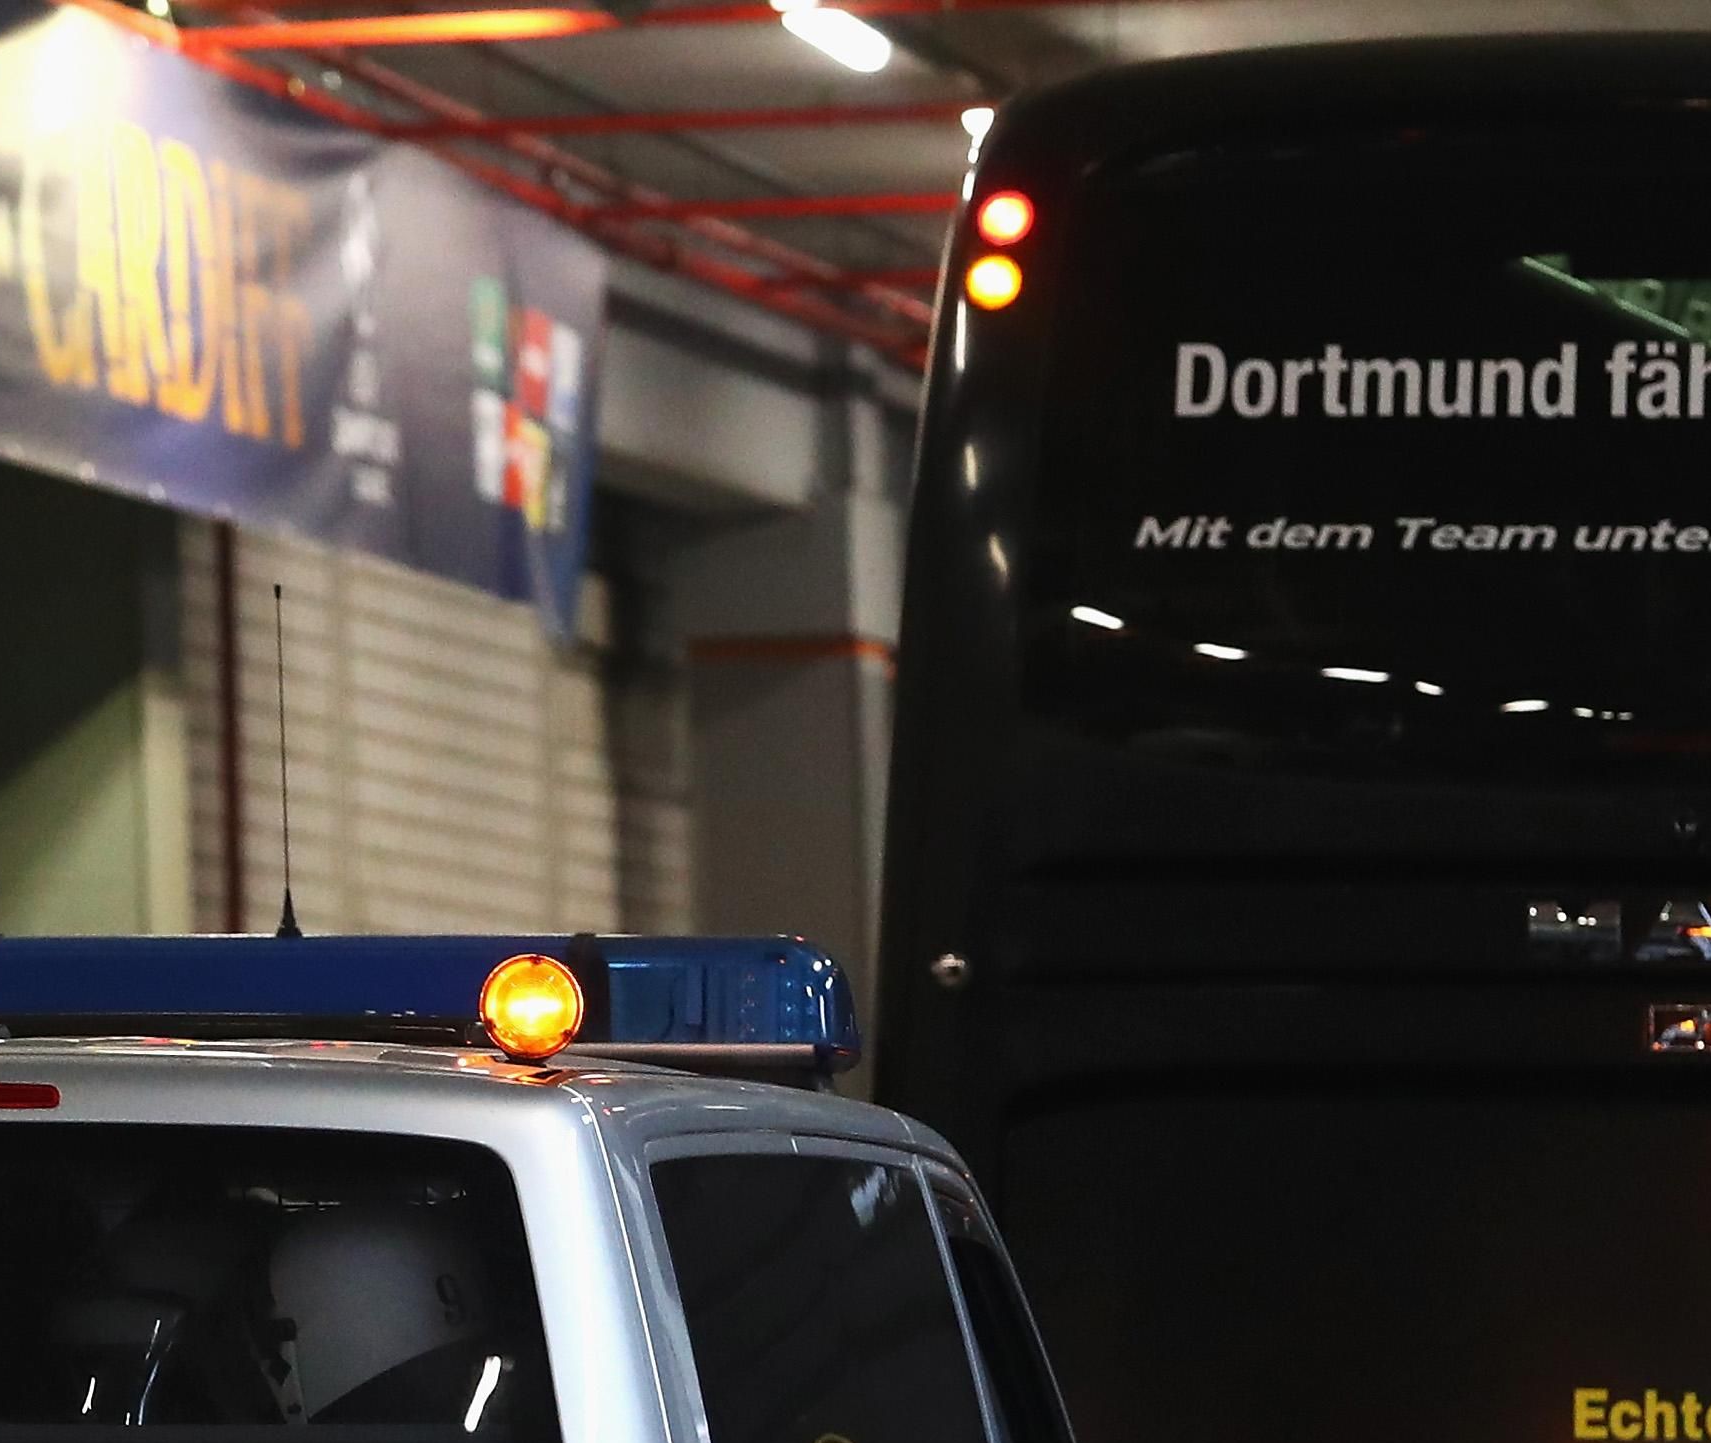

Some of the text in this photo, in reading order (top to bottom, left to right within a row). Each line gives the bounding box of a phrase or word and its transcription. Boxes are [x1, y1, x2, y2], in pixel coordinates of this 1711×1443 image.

[1175, 342, 1578, 418] Dortmund
[1134, 515, 1232, 549] Mit
[1246, 516, 1374, 550] dem
[1396, 517, 1557, 551] Team
